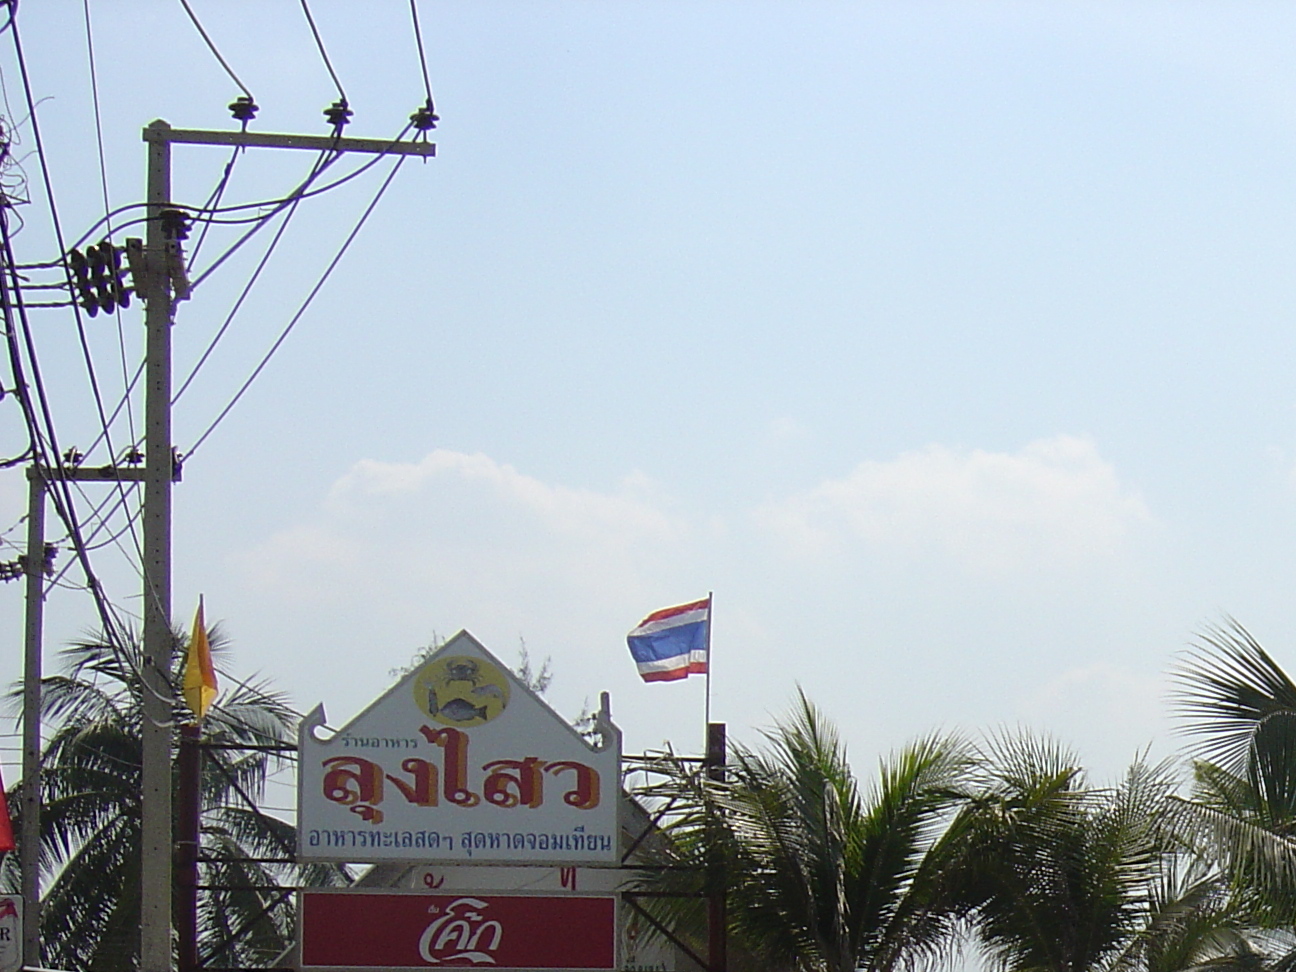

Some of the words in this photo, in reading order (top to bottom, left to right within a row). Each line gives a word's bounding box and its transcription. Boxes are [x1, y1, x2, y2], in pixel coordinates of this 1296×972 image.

[322, 724, 600, 824] ลุงไสว
[461, 825, 612, 857] สุดหาดจอมเทียน
